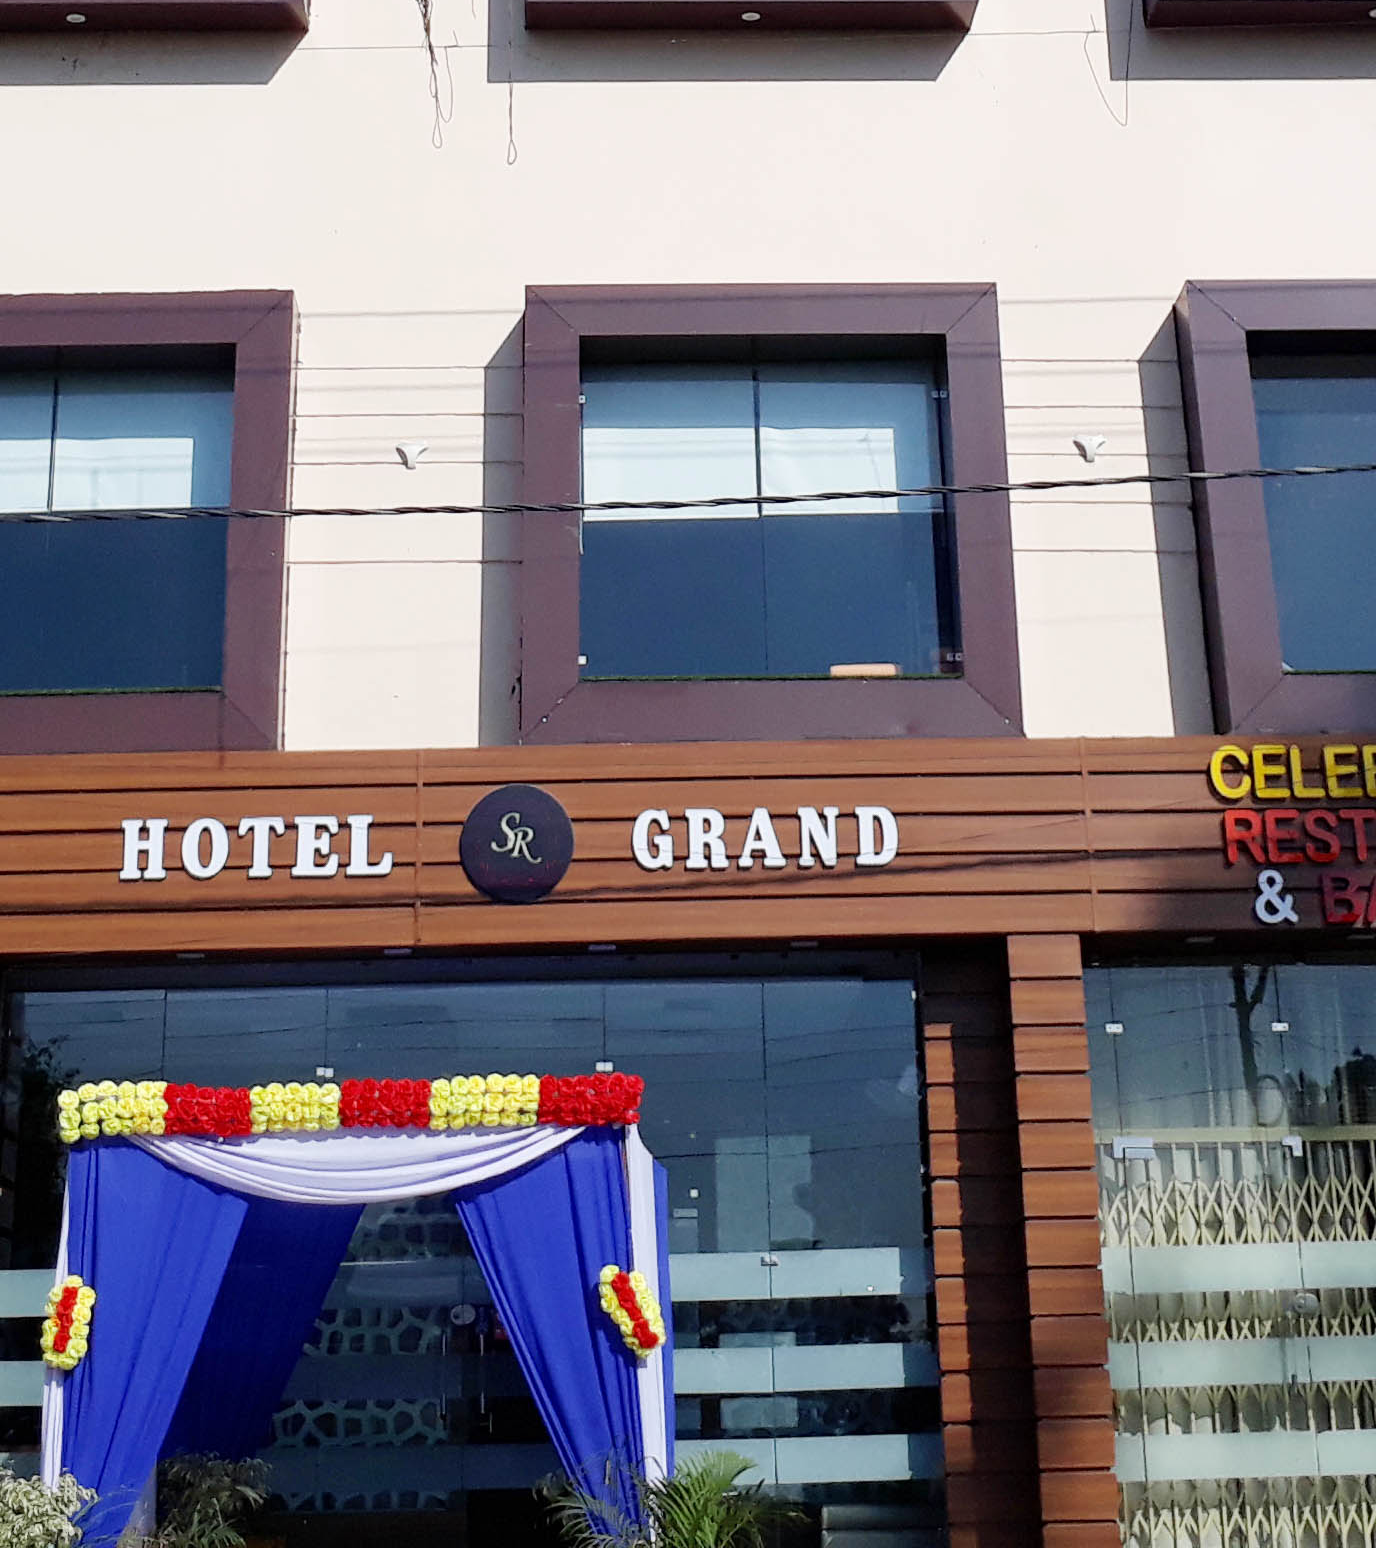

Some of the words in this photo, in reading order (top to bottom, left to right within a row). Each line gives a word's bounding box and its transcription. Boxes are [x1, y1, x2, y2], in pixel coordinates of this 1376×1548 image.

[119, 814, 394, 881] HOTEL
[632, 806, 900, 870] GRAND
[1255, 869, 1300, 925] &
